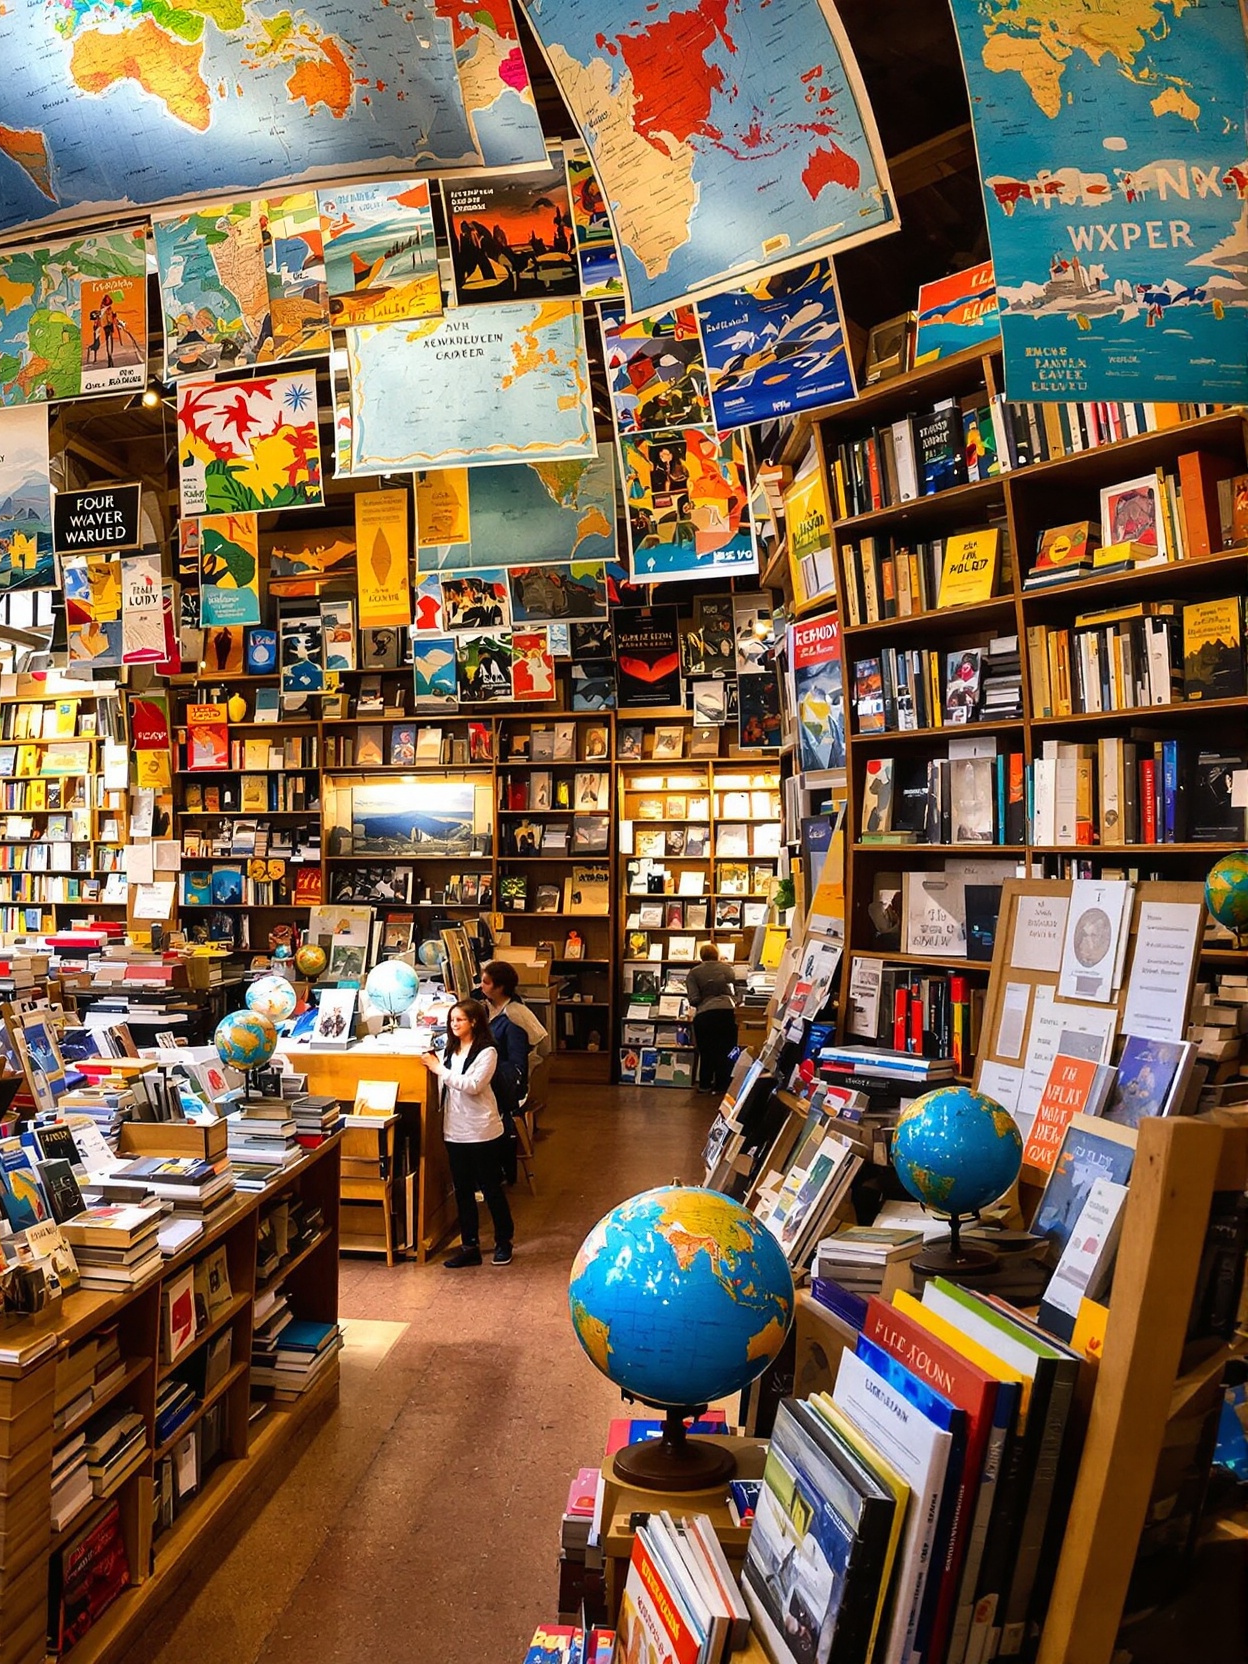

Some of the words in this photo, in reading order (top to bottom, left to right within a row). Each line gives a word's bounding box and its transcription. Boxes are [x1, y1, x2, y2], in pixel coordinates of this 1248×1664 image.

[1067, 220, 1195, 252] WXPER
[76, 495, 115, 512] FOUR
[65, 526, 127, 544] WARUED
